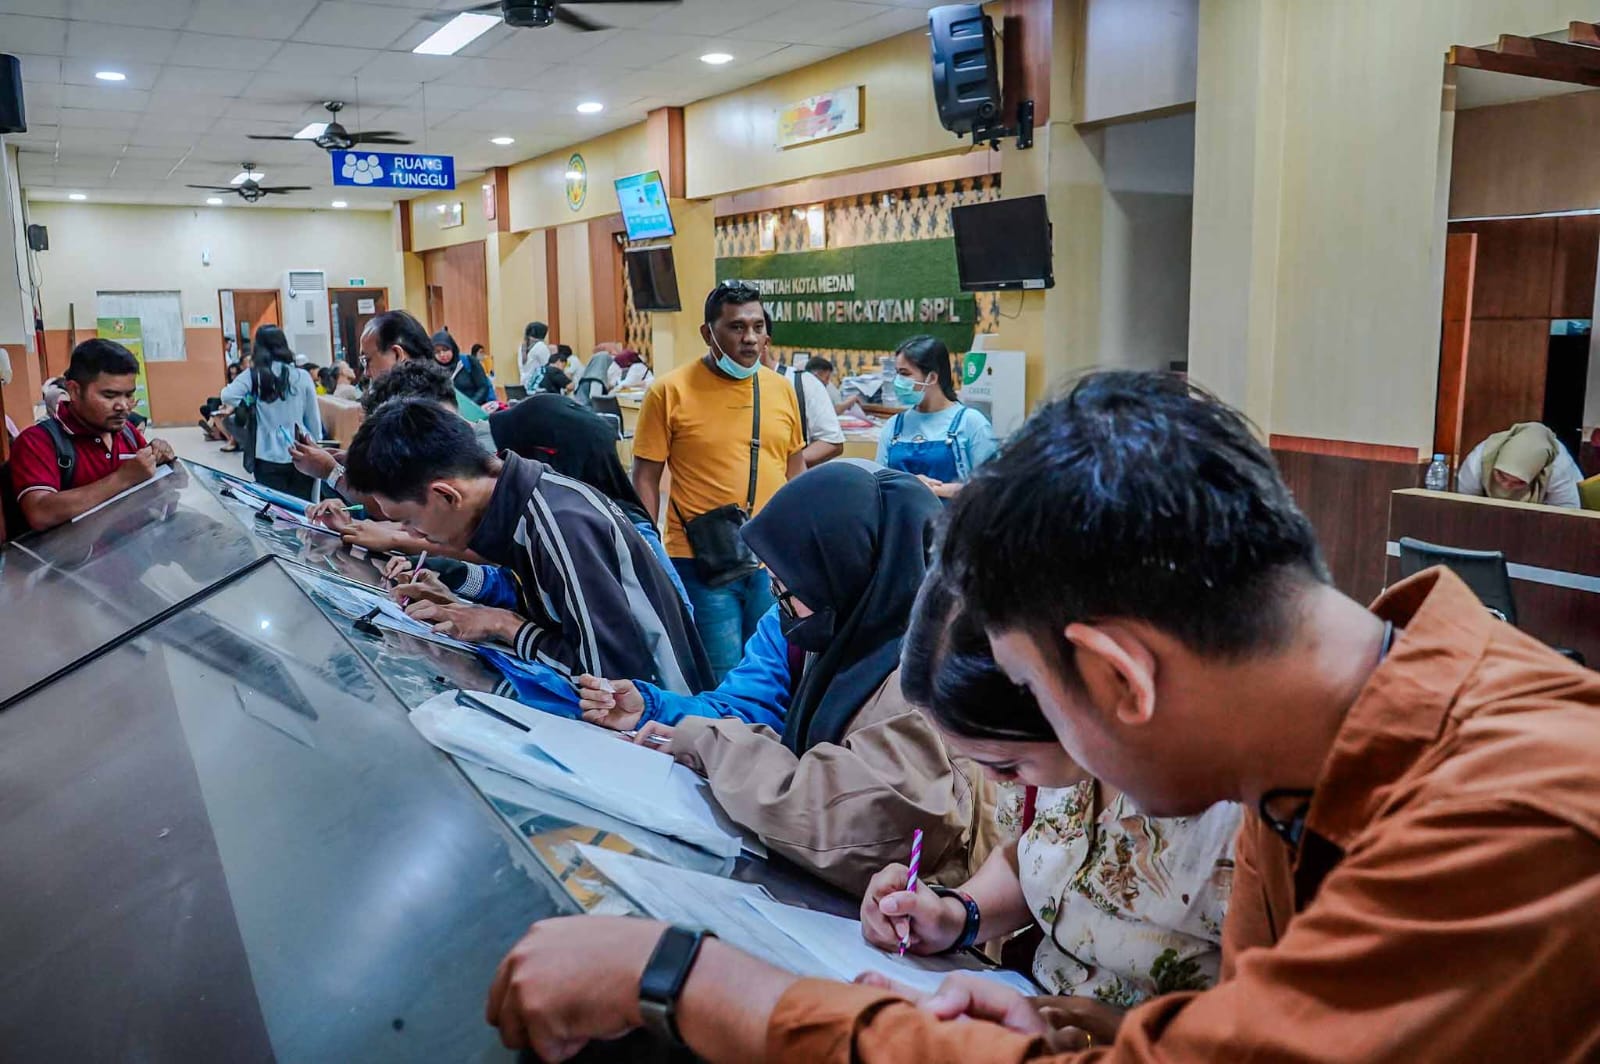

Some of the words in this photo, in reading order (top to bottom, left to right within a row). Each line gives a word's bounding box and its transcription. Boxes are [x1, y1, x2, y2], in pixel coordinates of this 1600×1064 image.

[394, 157, 443, 170] RUANG
[390, 172, 448, 187] TUNGGU
[791, 277, 817, 295] KOTA
[818, 274, 855, 293] MEDAN
[798, 301, 823, 322] DAN
[827, 299, 914, 323] PENCATATAN
